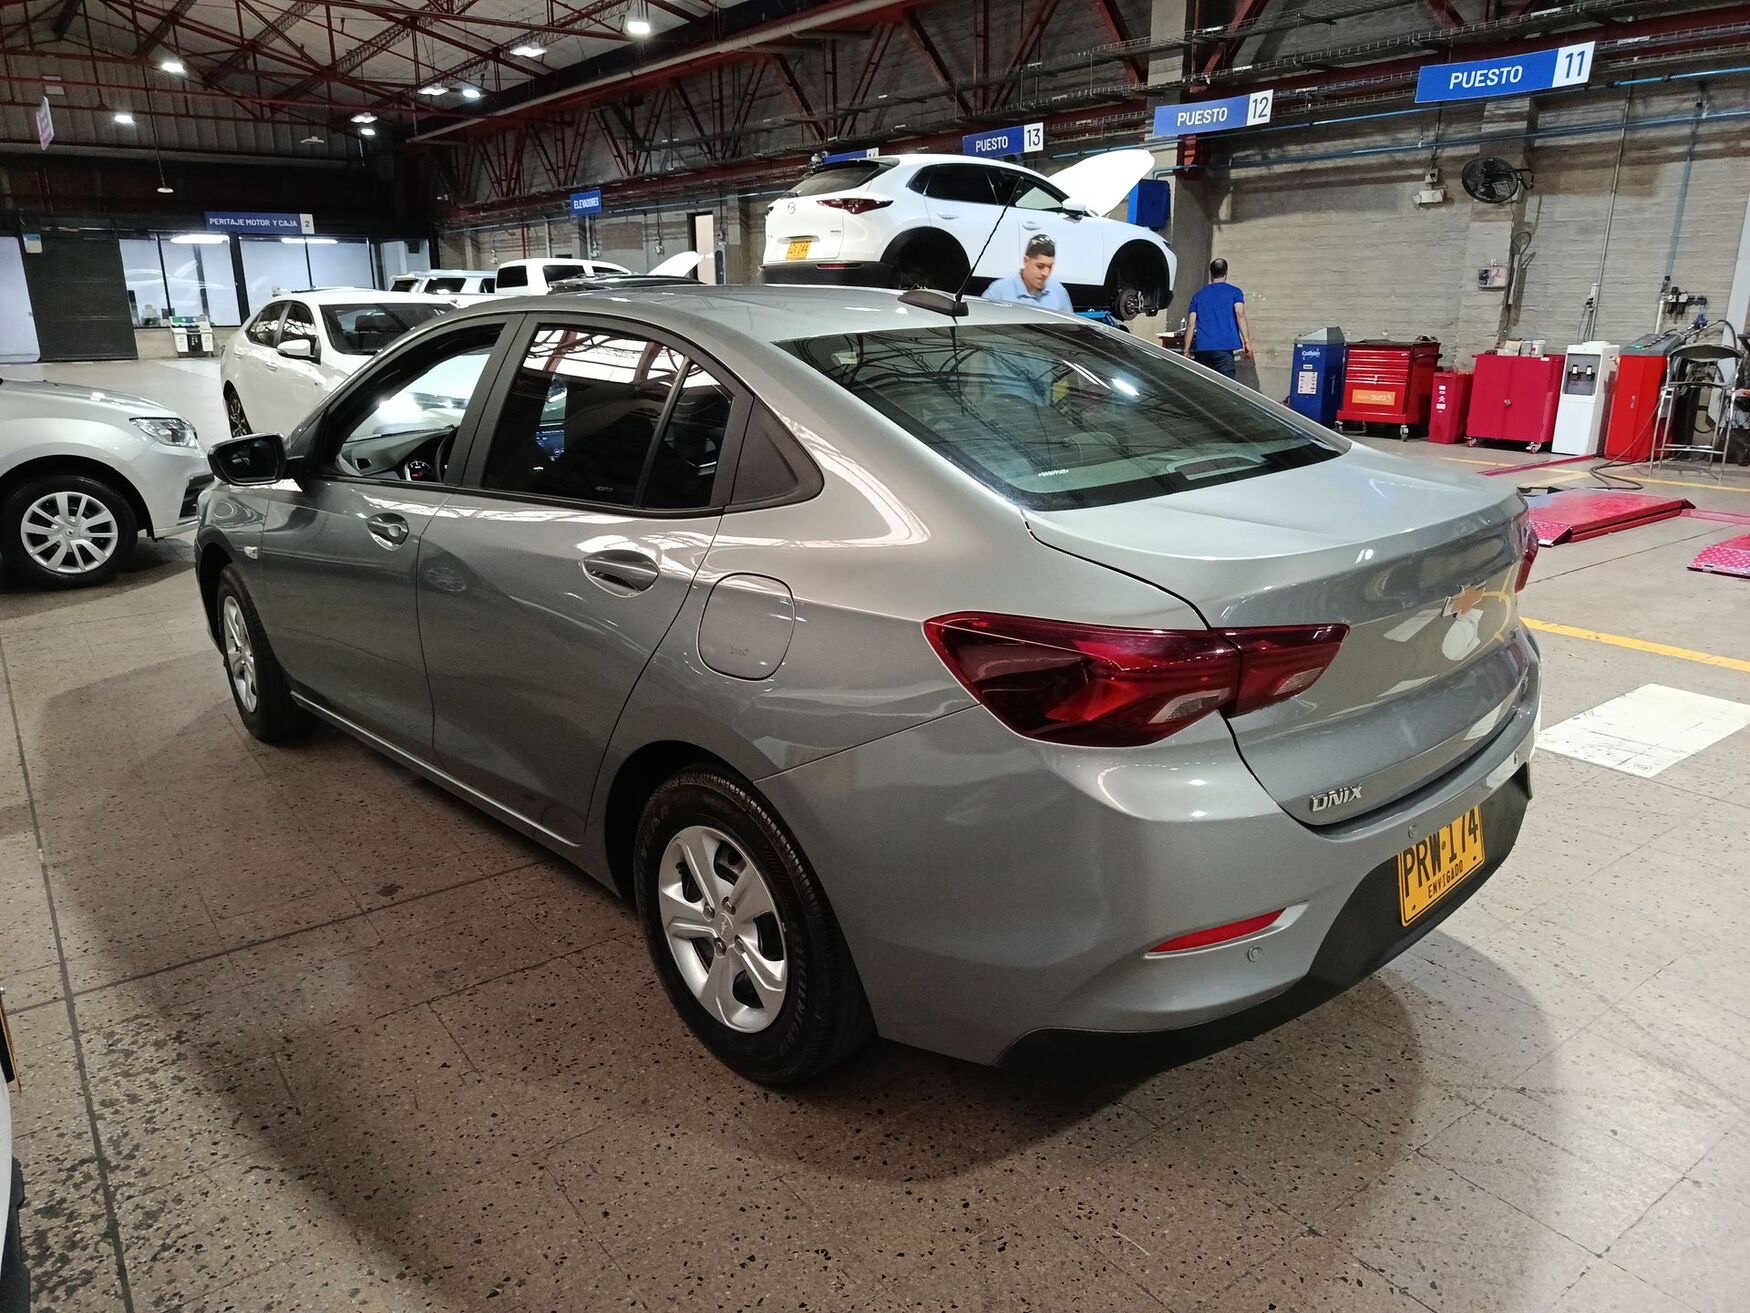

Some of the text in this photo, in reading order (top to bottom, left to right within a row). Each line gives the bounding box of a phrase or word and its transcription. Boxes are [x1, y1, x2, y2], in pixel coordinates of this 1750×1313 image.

[1449, 50, 1586, 90] PUESTO 11
[1177, 96, 1269, 127] PUESTO 12
[975, 128, 1041, 153] PUESTO 13
[209, 218, 245, 226] PERITAJE
[245, 219, 271, 227] MOTOR
[279, 220, 298, 228] CAJA
[305, 220, 311, 228] 2
[1310, 783, 1362, 813] ONIX
[1427, 859, 1464, 899] ENVIGADO
